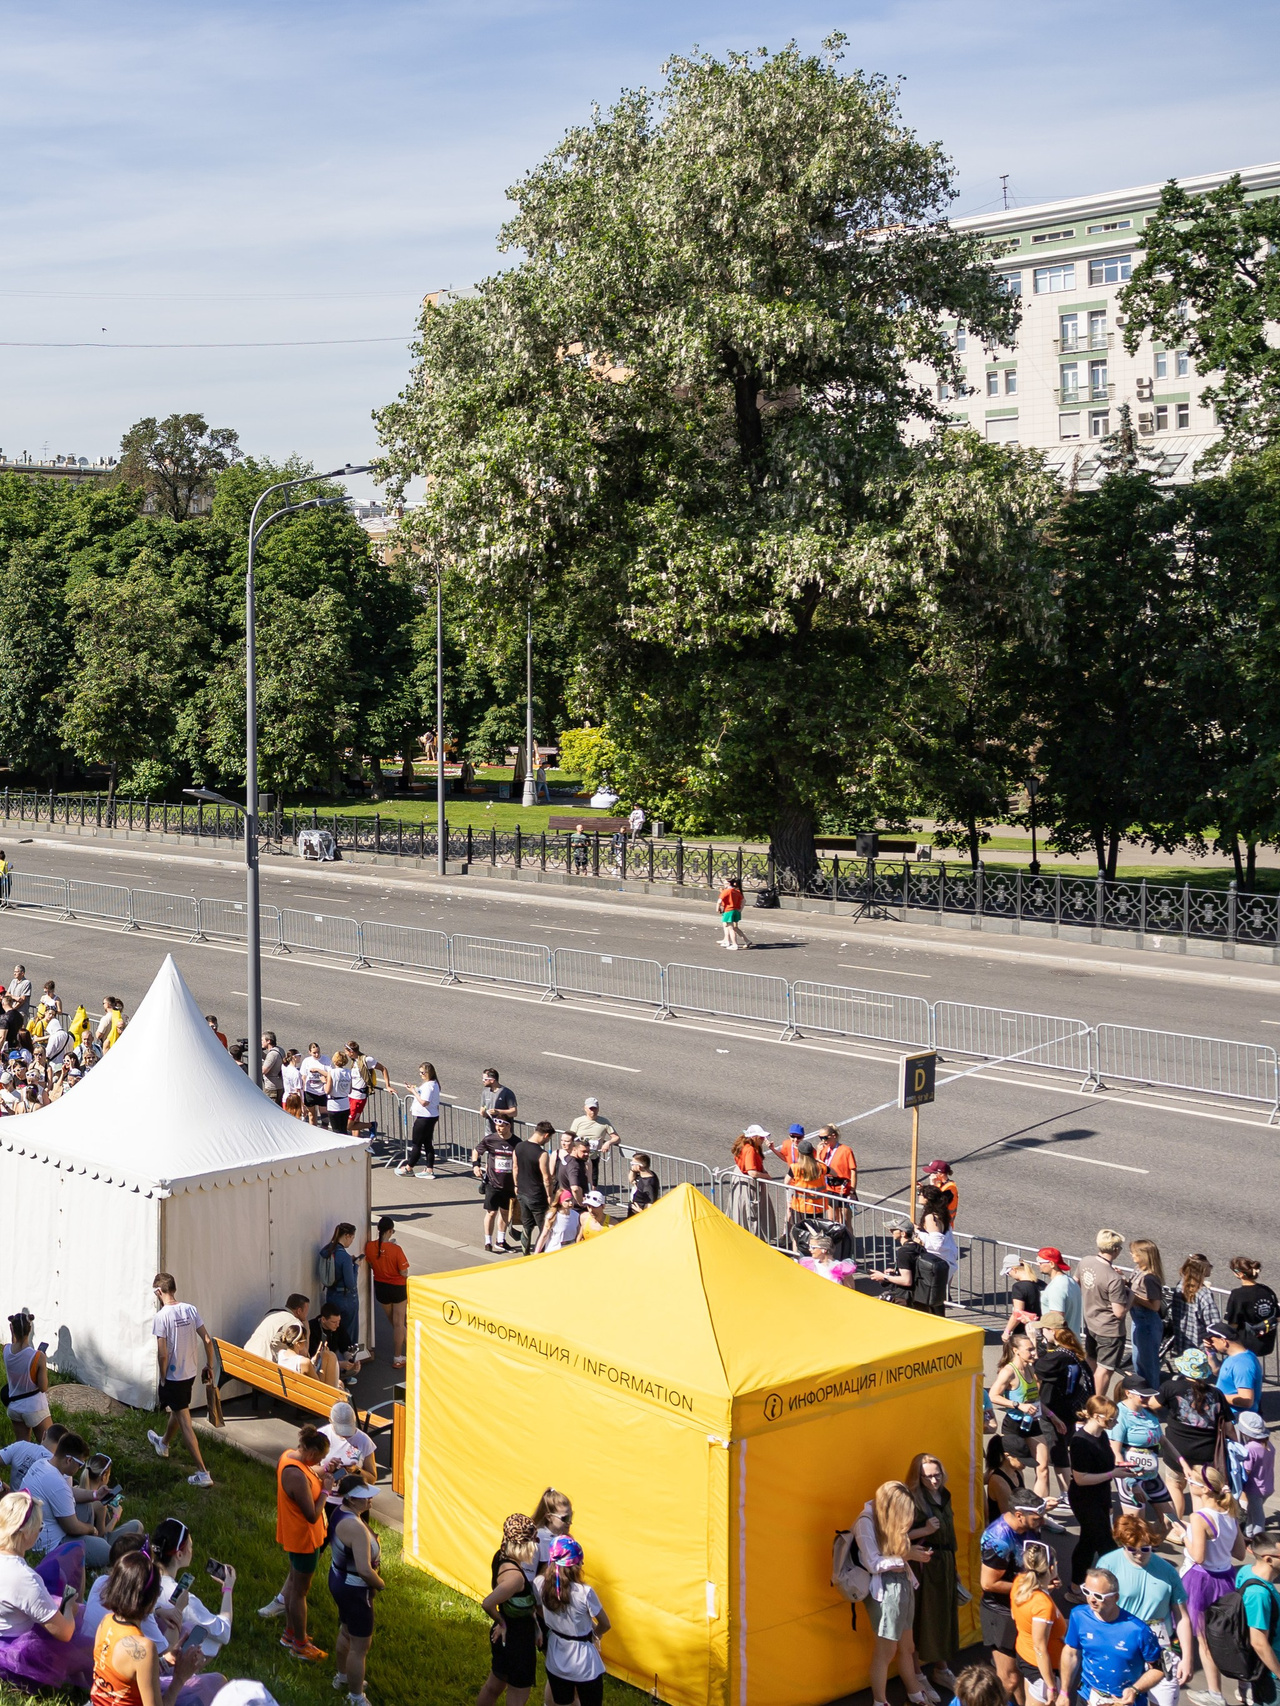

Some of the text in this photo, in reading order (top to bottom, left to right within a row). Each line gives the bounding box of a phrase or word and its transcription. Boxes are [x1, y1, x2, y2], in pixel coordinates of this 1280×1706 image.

[915, 1068, 926, 1092] D
[467, 1313, 570, 1364] ИНФОРМАЦИЯ
[583, 1356, 694, 1413] INFORMATION
[788, 1373, 877, 1411] ИНФОРМАЦИЯ
[886, 1352, 963, 1384] INFORMATION
